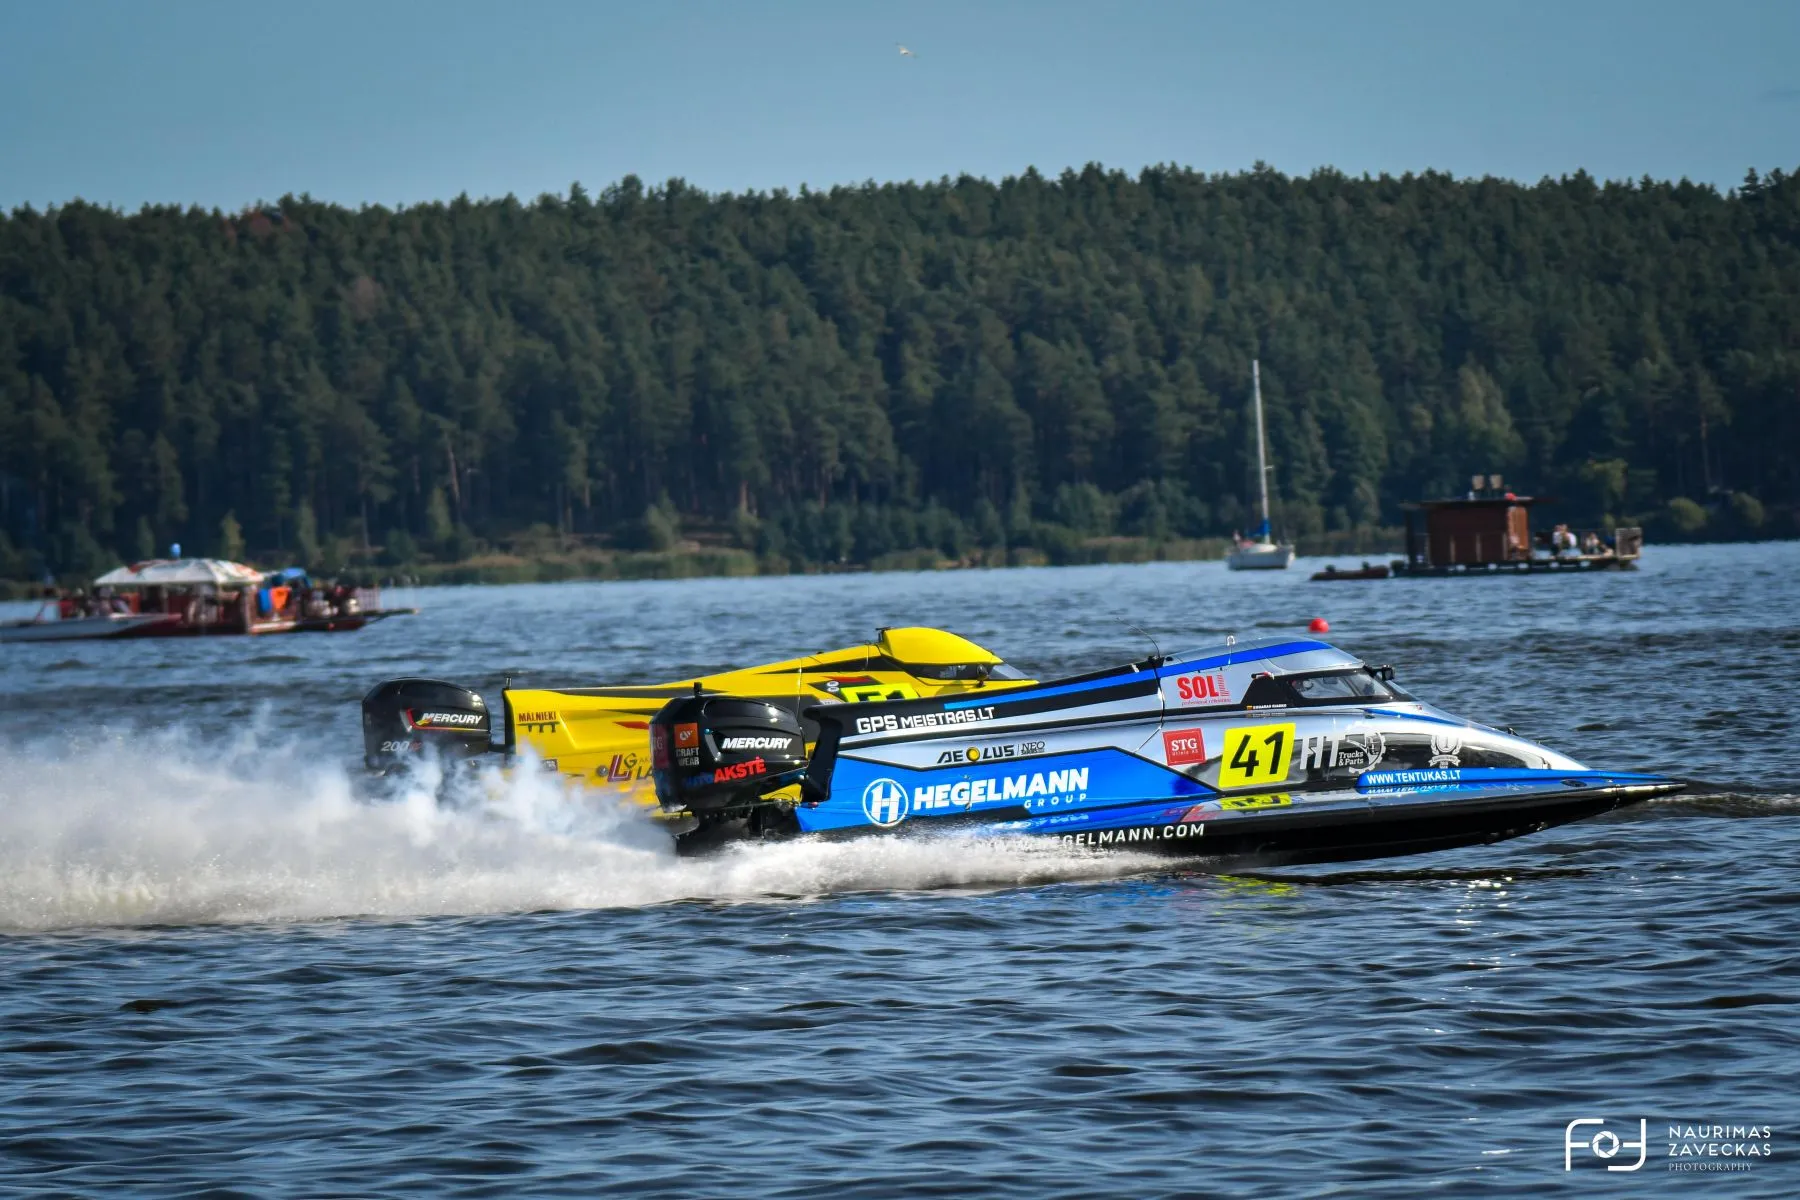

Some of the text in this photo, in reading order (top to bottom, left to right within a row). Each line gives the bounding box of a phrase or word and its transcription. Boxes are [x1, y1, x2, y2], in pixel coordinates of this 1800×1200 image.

[1177, 675, 1219, 700] SOL
[421, 713, 484, 724] MERCURY
[856, 707, 995, 734] GPS MEISTRAS.LT
[721, 737, 793, 749] MERCURY
[1171, 737, 1198, 752] STG
[1230, 731, 1285, 777] 41
[1338, 750, 1364, 759] Trucks
[1344, 758, 1364, 766] Parts
[1366, 769, 1461, 785] WWW.TENTUKAS.LT
[913, 767, 1089, 811] HEGELMANN
[1023, 792, 1087, 809] GROUP
